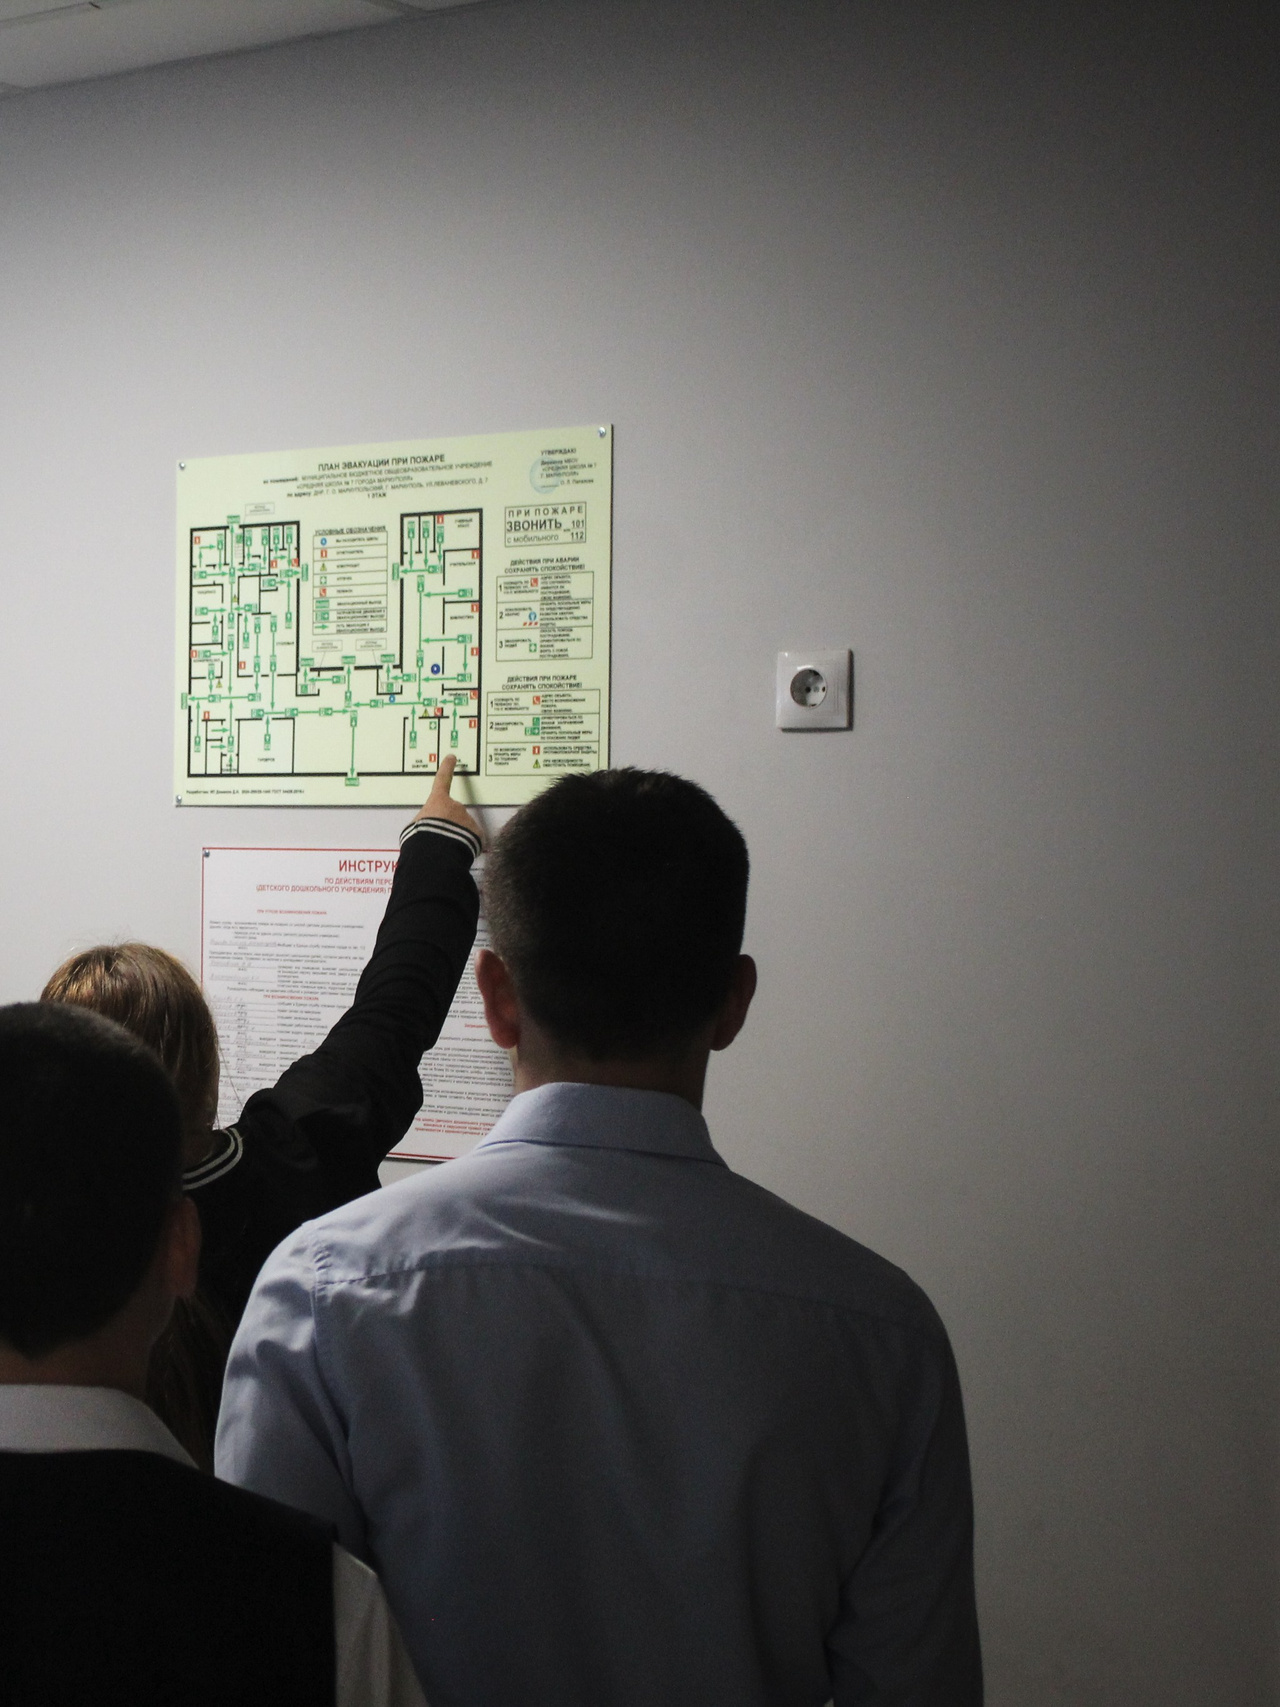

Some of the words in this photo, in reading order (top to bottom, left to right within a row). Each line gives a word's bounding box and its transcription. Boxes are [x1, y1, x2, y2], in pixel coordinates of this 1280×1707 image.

[318, 462, 340, 472] ПЛАН
[342, 459, 390, 470] ЭВАКУАЦИИ
[392, 458, 408, 466] ПРИ
[410, 454, 445, 465] ПОЖАРЕ
[508, 509, 531, 518] ПРИ
[534, 505, 584, 517] ПОЖАРЕ
[506, 518, 562, 532] ЗВОНИТЬ
[571, 520, 585, 529] 101
[513, 534, 559, 543] мобильного
[571, 531, 584, 540] 112
[499, 584, 502, 592] 1
[499, 611, 504, 620] 2
[499, 640, 503, 649] 3
[507, 675, 538, 683] ДЕЙСТВИЯ
[335, 877, 374, 885] ДЕЙСТВИЯМ
[291, 885, 340, 893] ДОШКОЛЬНОГО
[340, 886, 387, 894] УЧРЕЖДЕНИЯ)
